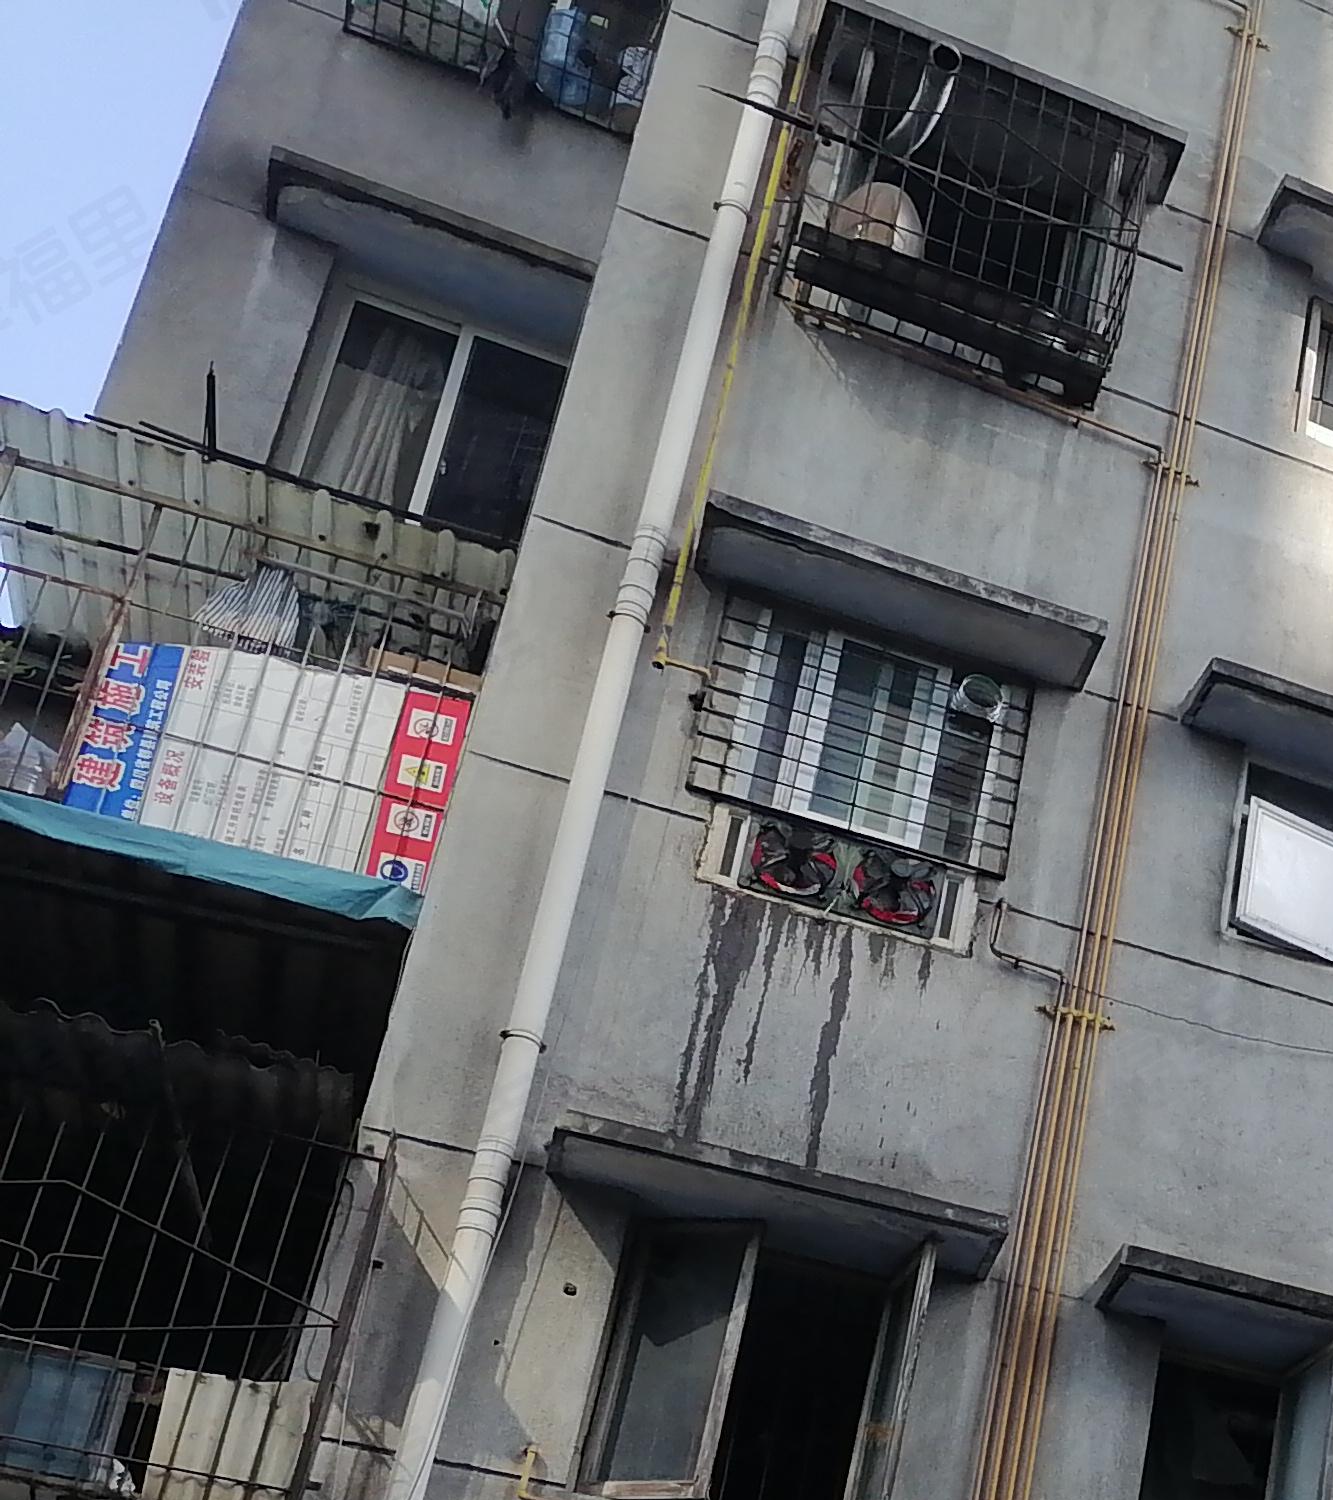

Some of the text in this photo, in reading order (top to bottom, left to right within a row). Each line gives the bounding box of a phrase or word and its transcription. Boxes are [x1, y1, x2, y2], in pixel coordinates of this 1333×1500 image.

[73, 643, 153, 791] 建筑施工
[154, 750, 184, 806] 设备概况
